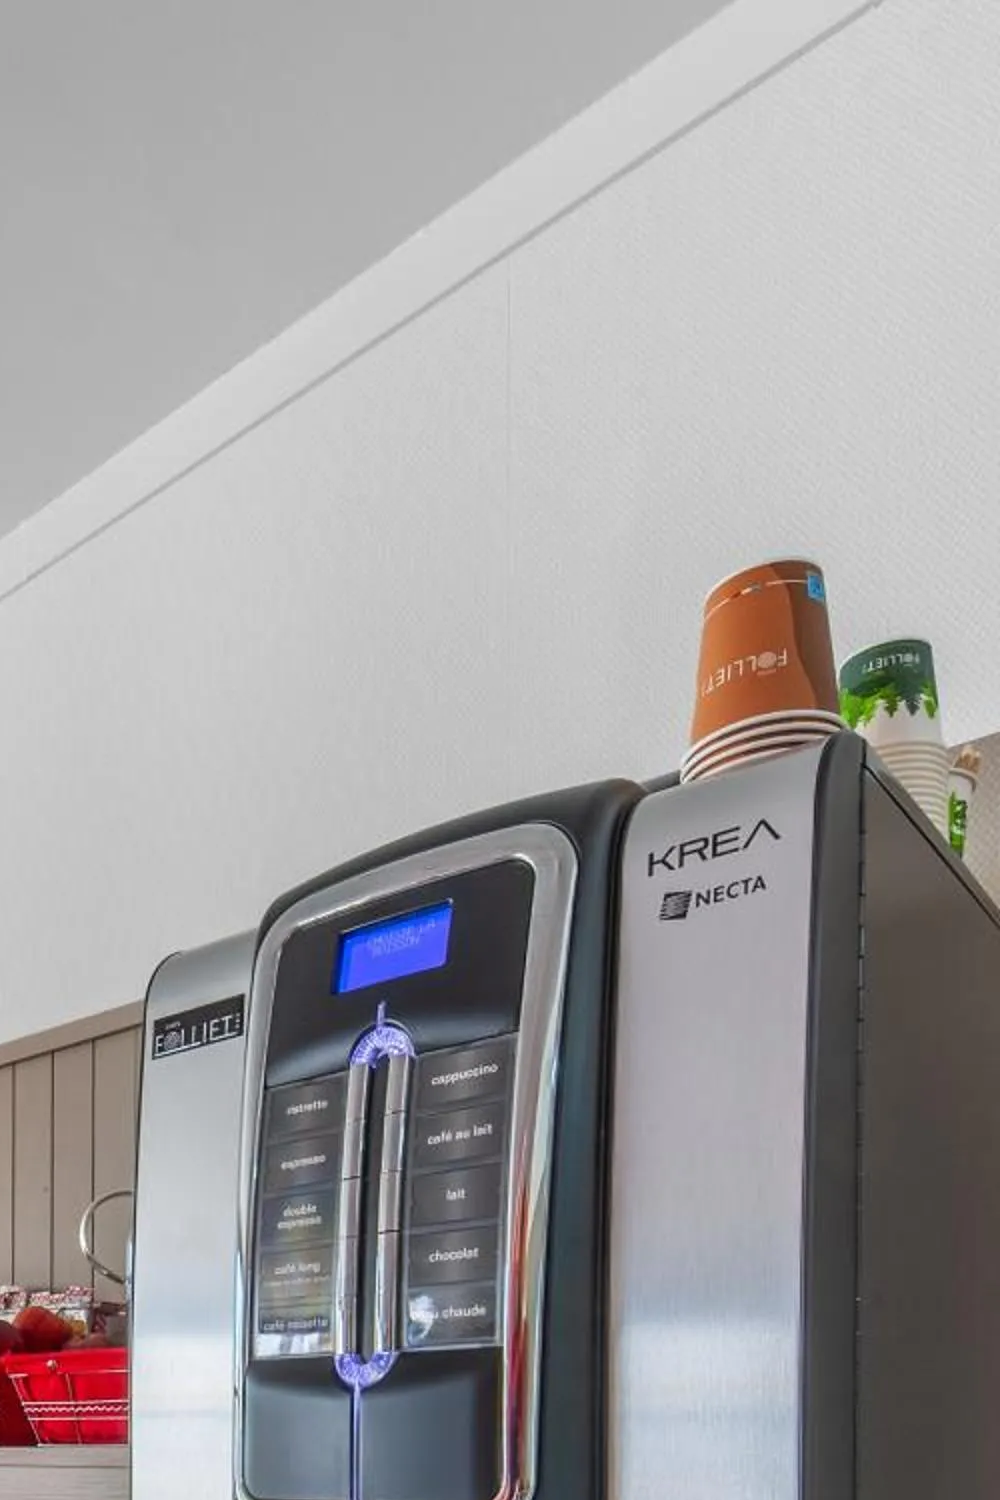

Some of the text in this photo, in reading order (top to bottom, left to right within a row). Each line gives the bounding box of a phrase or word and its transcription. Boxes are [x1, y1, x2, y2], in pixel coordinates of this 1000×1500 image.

[695, 875, 767, 908] NECTA
[431, 1063, 499, 1086] cappuccino
[427, 1123, 493, 1145] café au lait
[445, 1187, 467, 1201] lait
[428, 1247, 480, 1263] chocolat
[442, 1303, 487, 1319] chaude
